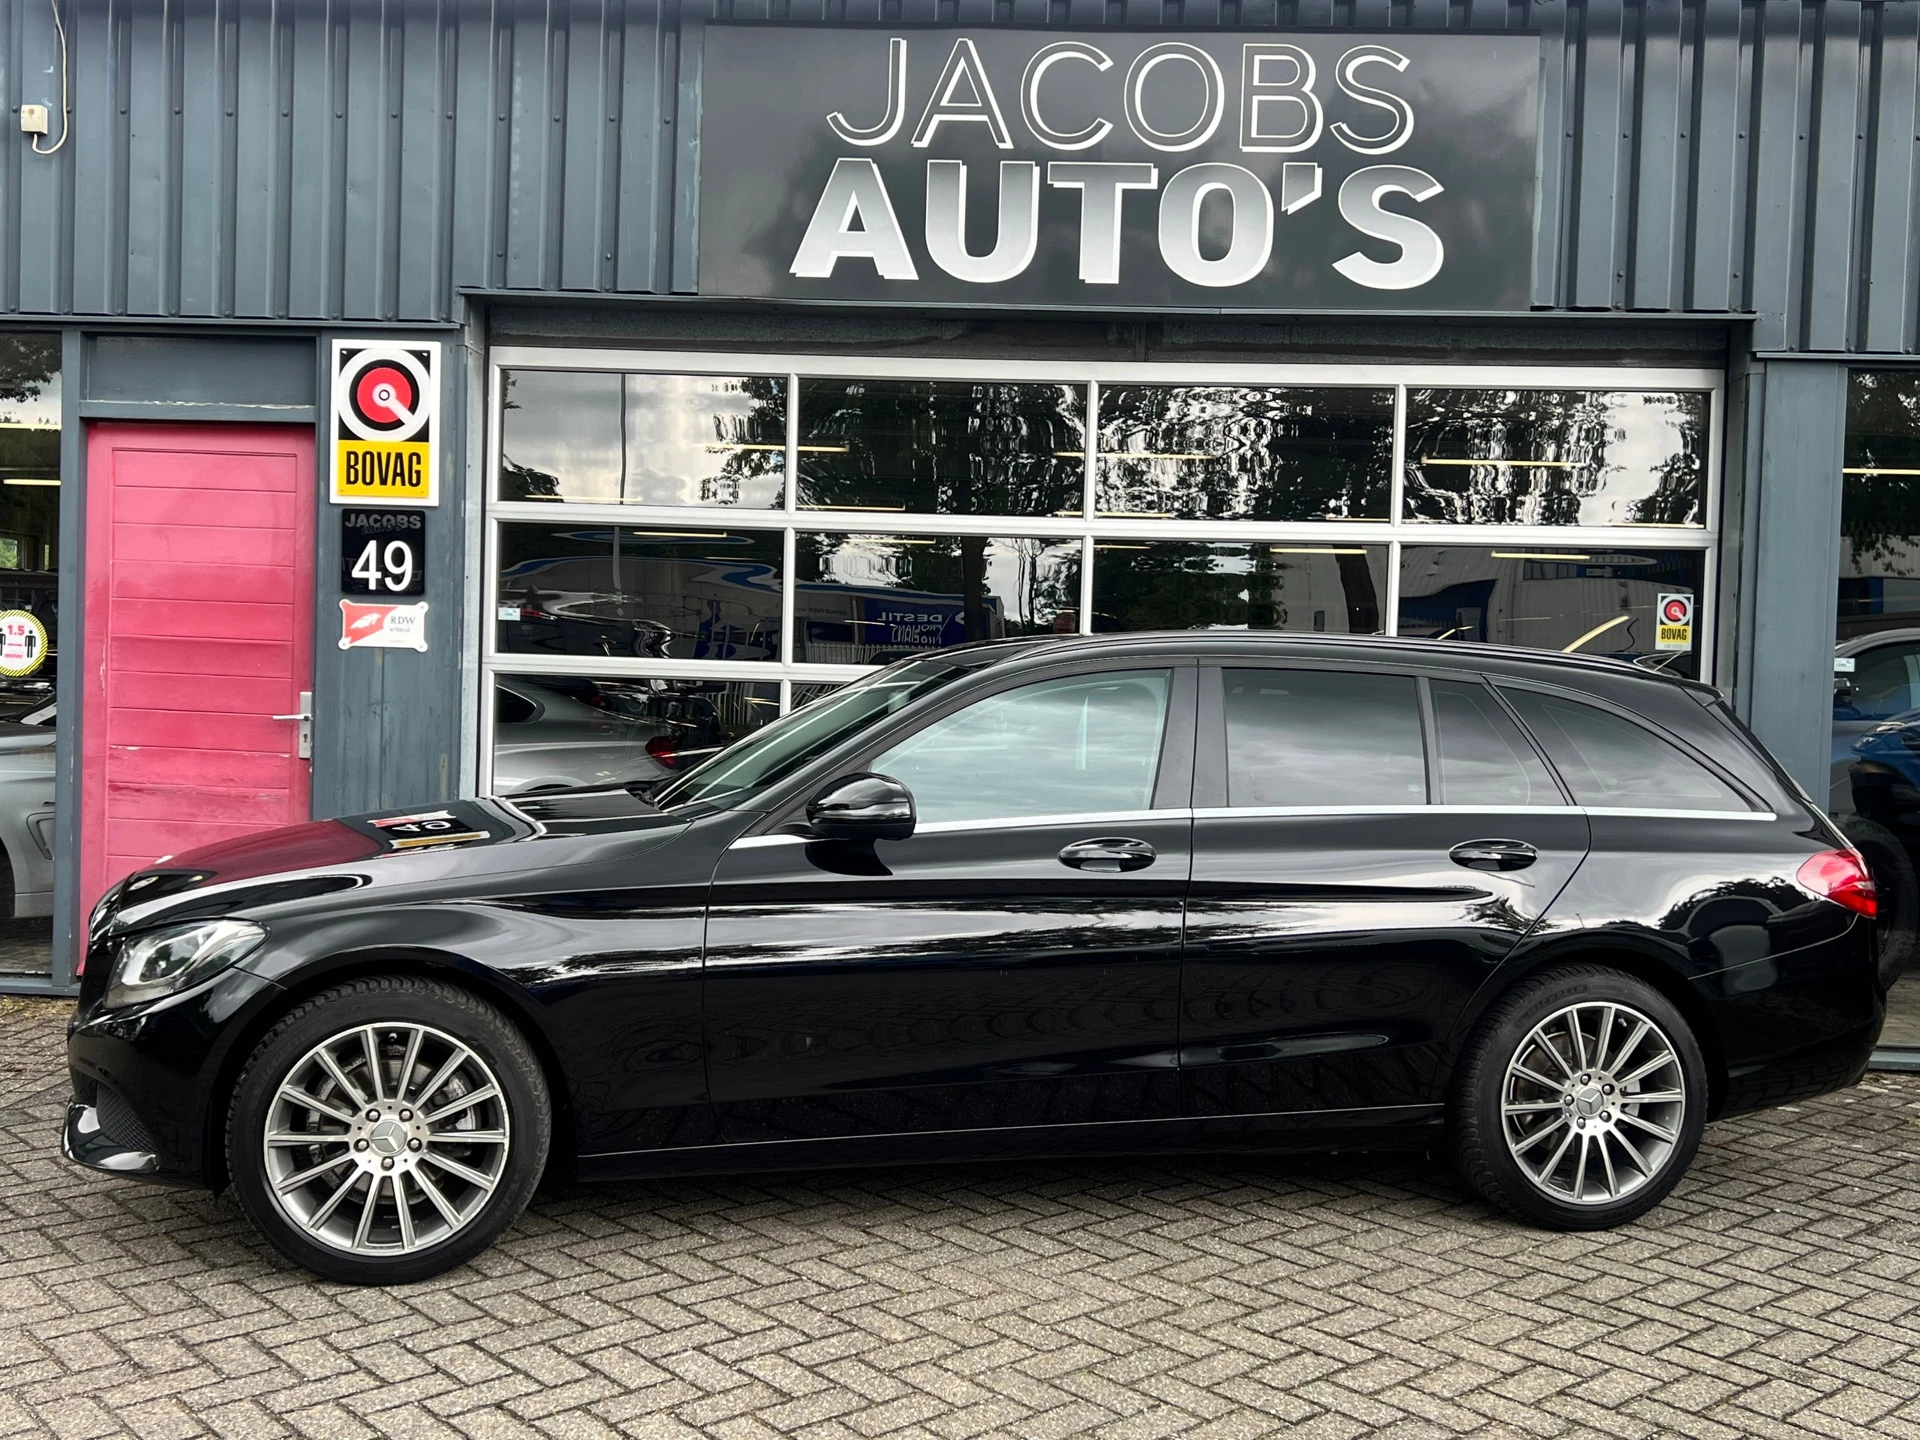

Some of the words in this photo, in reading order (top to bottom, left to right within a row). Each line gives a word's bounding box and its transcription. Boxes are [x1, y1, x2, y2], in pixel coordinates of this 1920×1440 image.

[826, 37, 1415, 156] JACOBS
[788, 157, 1446, 290] AUTO'S
[345, 450, 422, 488] BOVAG
[344, 512, 422, 530] JACOBS
[351, 539, 413, 592] 49
[7, 624, 25, 636] 1.5
[390, 616, 416, 625] RDW
[1661, 628, 1687, 641] BOVAG
